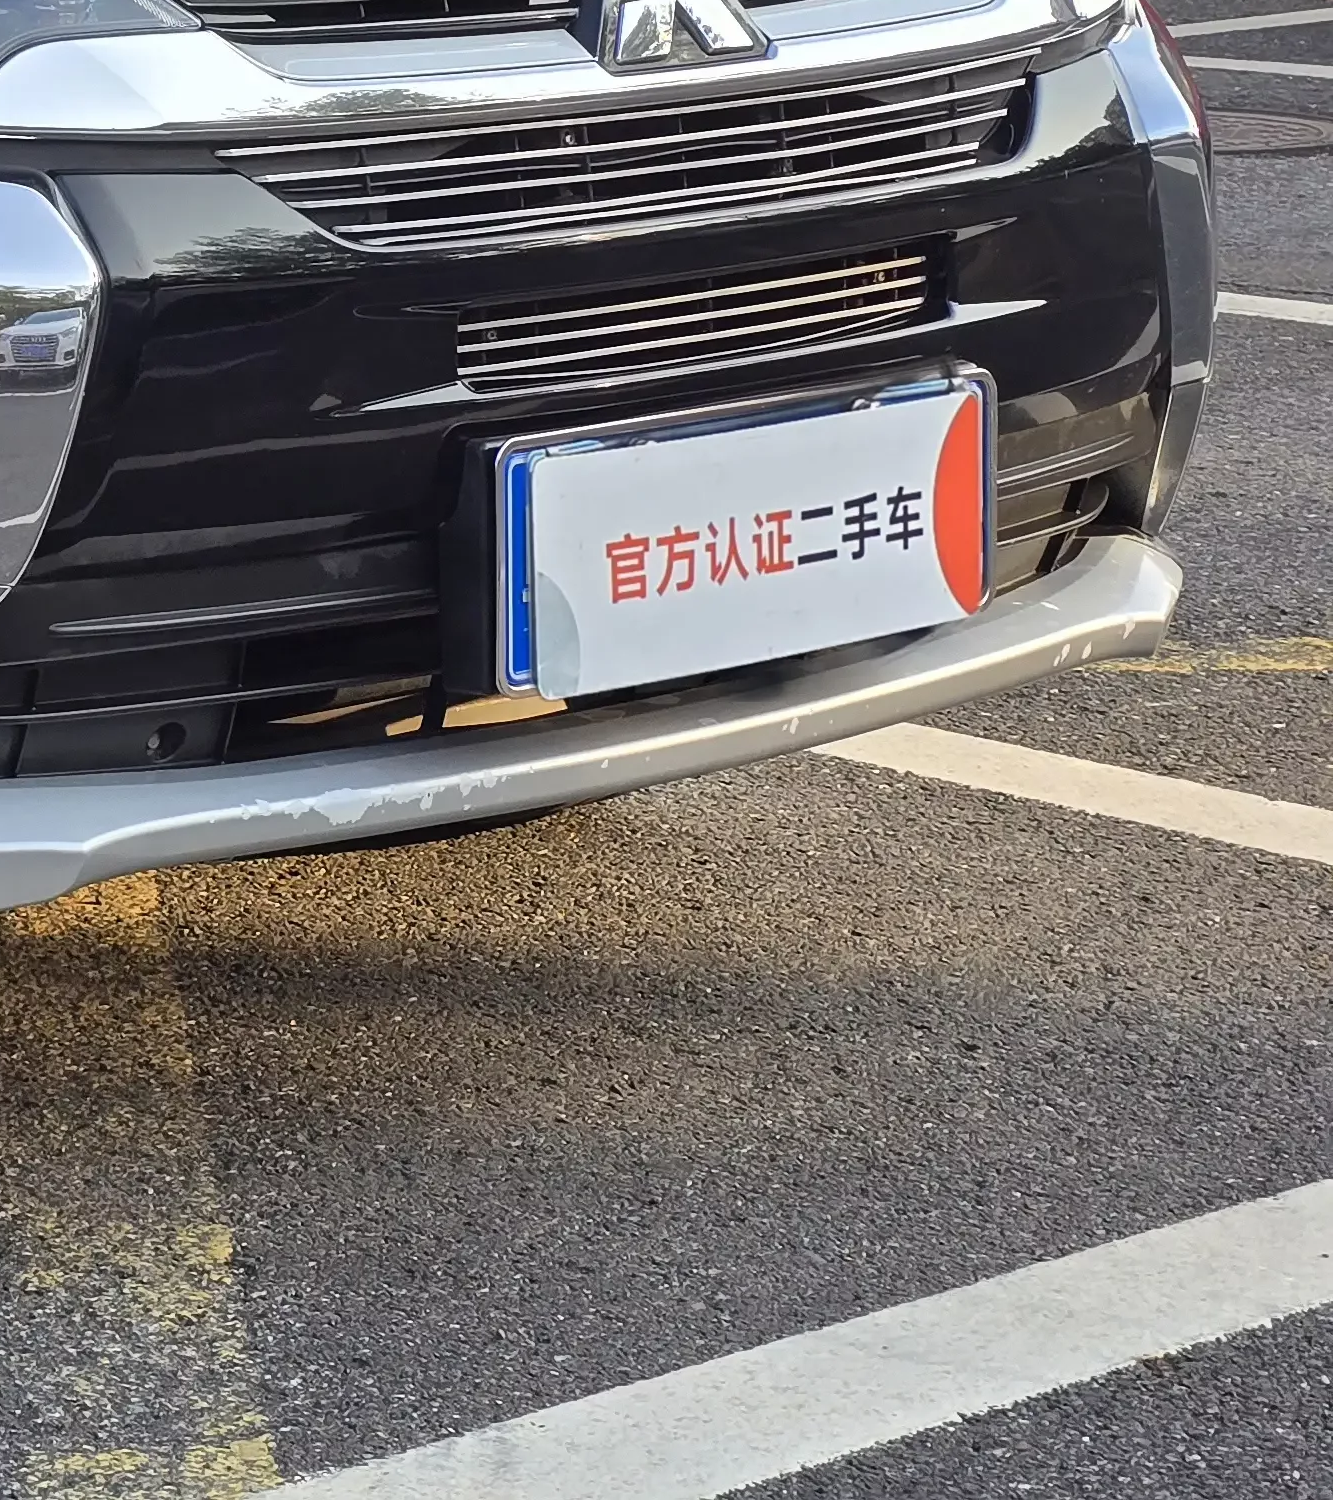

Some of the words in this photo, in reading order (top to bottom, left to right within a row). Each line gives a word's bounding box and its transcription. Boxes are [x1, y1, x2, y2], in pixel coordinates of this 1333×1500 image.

[605, 485, 925, 604] 官方认证二手车
